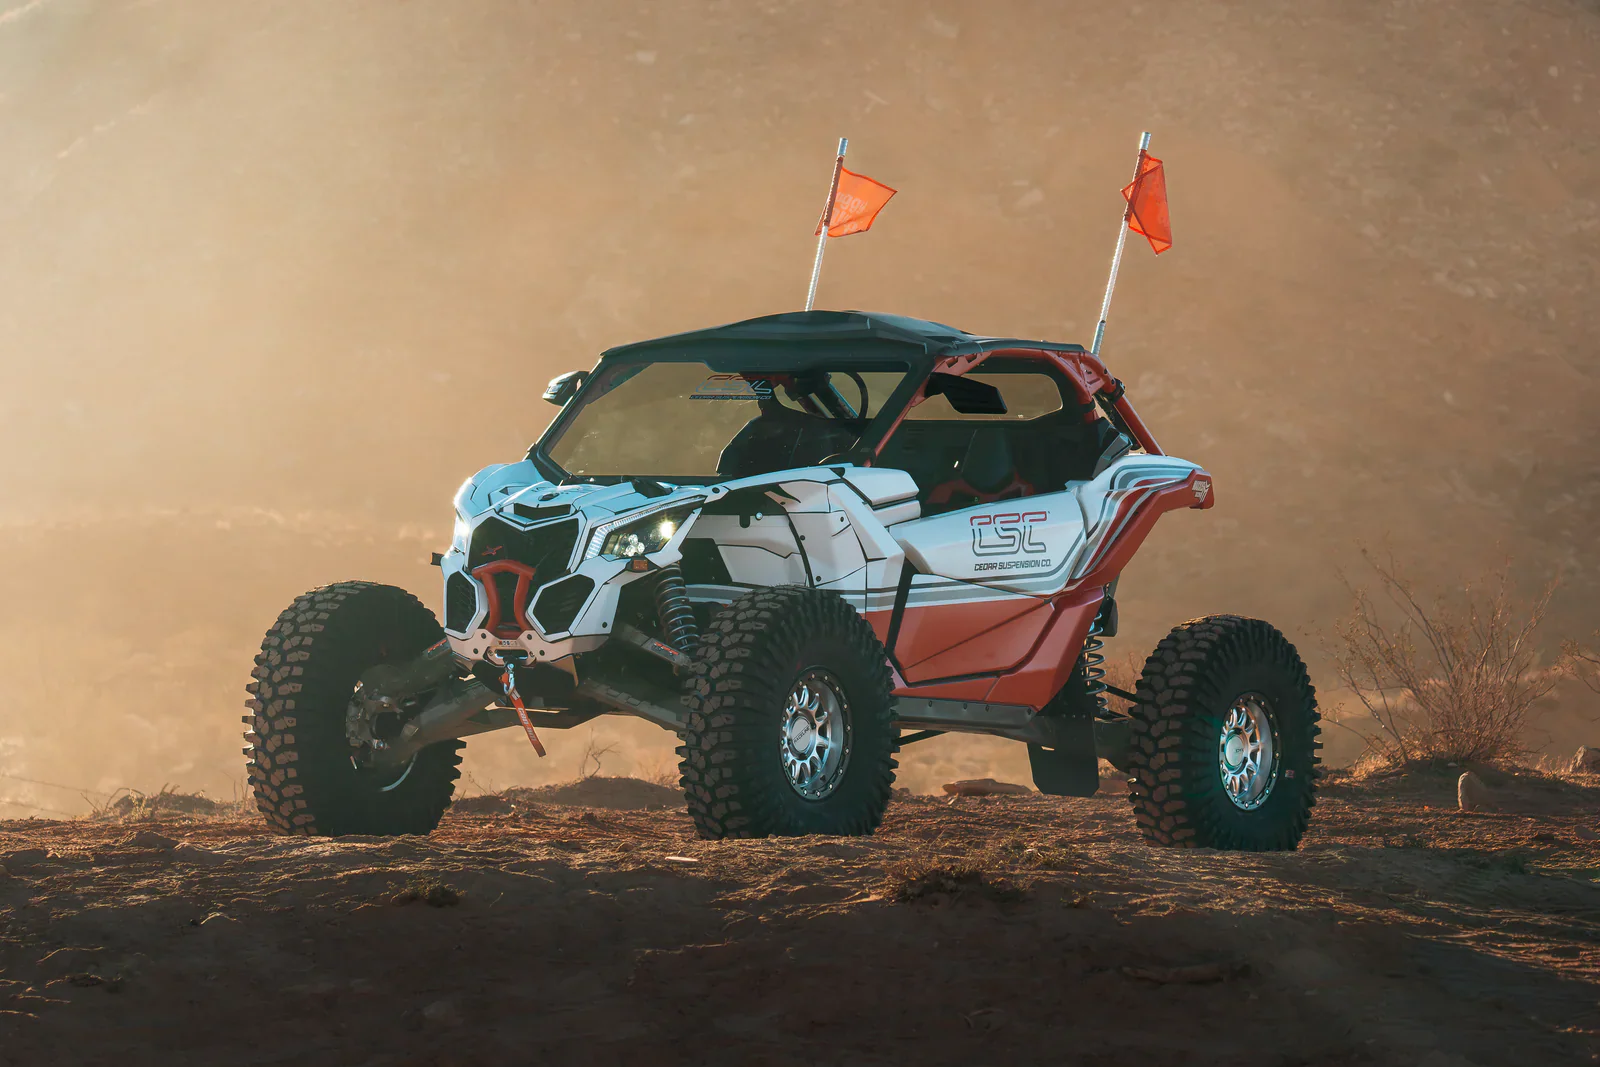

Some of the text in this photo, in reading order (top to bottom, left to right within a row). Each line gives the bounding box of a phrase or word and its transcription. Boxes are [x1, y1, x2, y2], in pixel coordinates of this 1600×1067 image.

[970, 511, 1047, 557] CSC
[974, 559, 1051, 571] CEDAR SUSPENSION CO.
